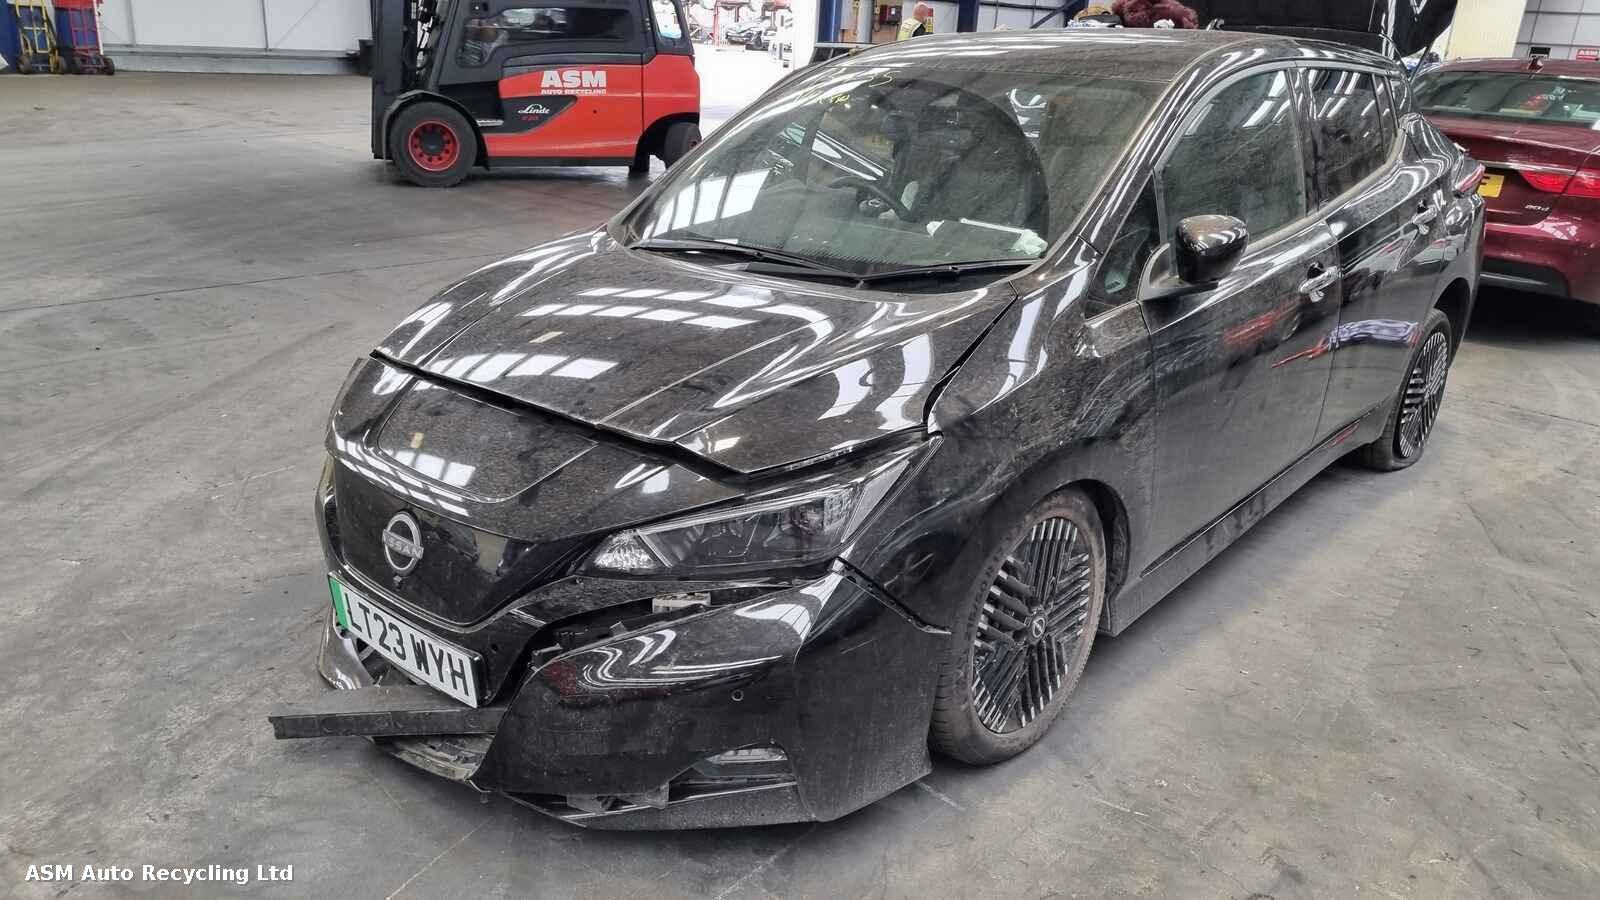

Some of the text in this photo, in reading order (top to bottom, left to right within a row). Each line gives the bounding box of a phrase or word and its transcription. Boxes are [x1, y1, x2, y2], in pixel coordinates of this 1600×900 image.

[541, 70, 607, 88] ASM
[518, 104, 550, 114] Linde
[384, 531, 423, 558] NISSAN
[345, 593, 469, 697] LT23 WYH
